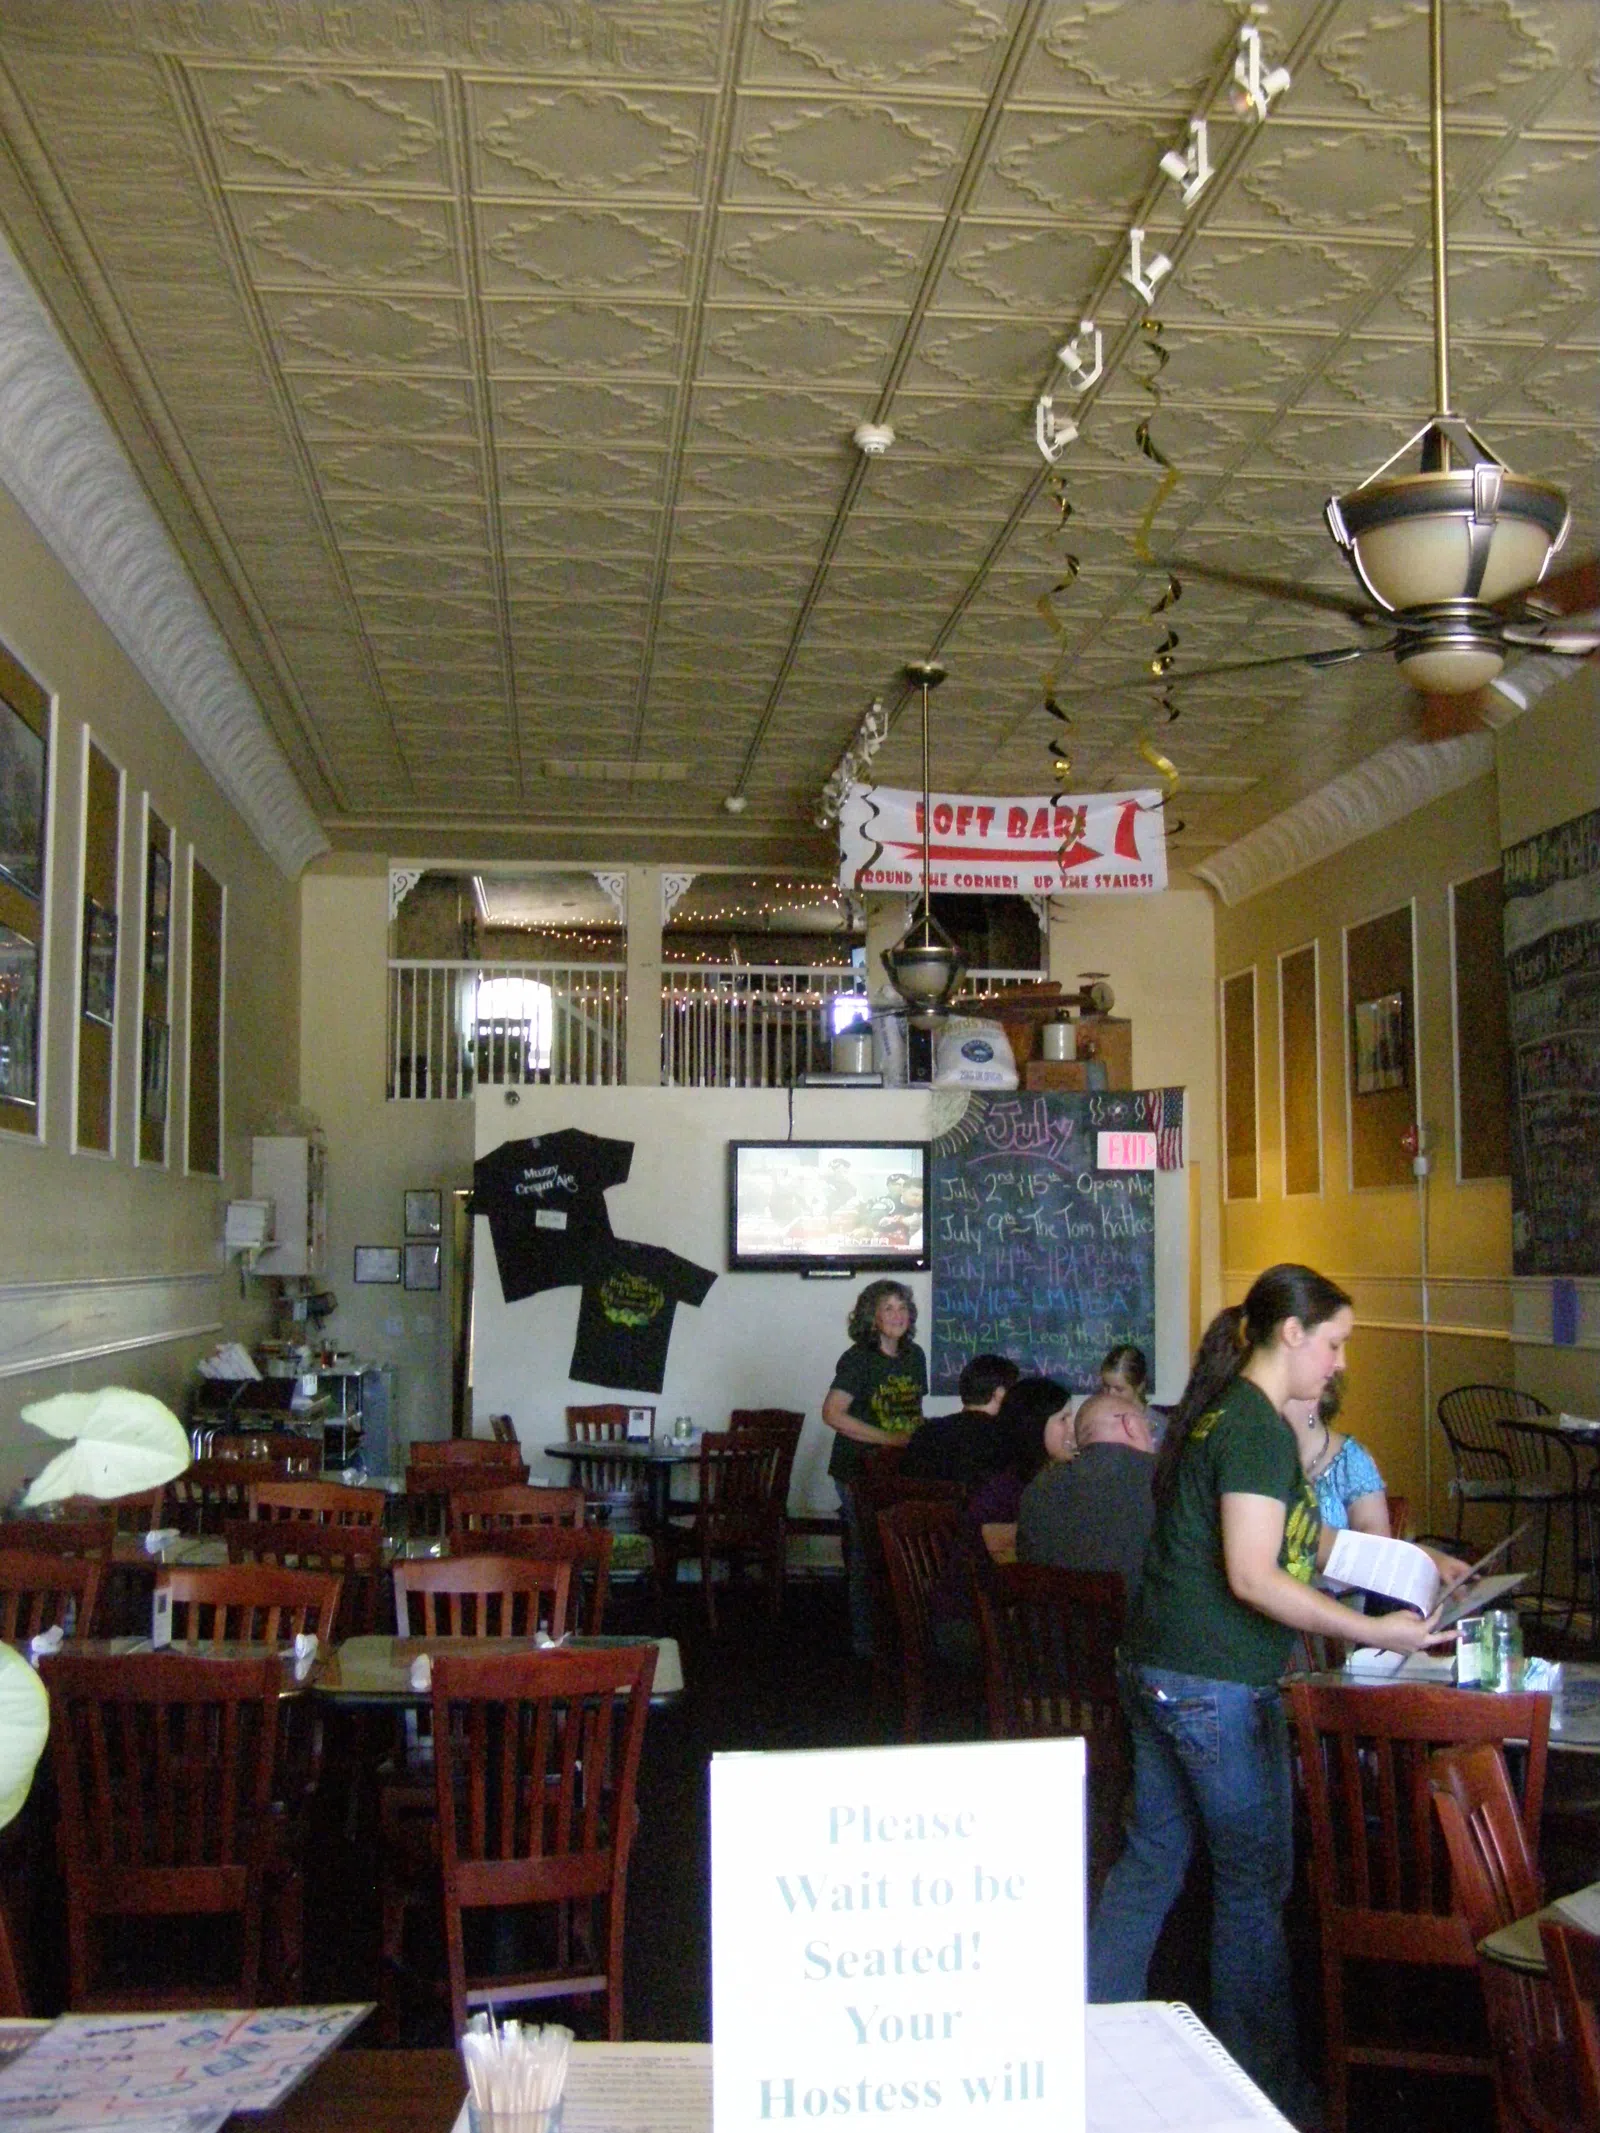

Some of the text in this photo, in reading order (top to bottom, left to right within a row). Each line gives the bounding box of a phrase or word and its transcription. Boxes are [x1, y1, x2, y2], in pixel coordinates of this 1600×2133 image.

[953, 873, 1018, 889] CORNER!
[1034, 875, 1053, 889] UP
[1060, 873, 1089, 888] THE
[1094, 873, 1153, 888] STAIRS!
[984, 1097, 1074, 1160] July
[1109, 1134, 1148, 1165] EXIT
[524, 1164, 558, 1181] Muzzy
[940, 1177, 981, 1212] July
[1076, 1172, 1124, 1204] Open
[940, 1213, 982, 1254] July
[1053, 1202, 1096, 1239] Tom
[828, 1804, 976, 1845] Please
[775, 1865, 1025, 1914] Wait to be
[804, 1931, 981, 1981] Seated!
[845, 2004, 963, 2046] Your
[757, 2075, 942, 2120] Hostess
[960, 2060, 1045, 2104] will
